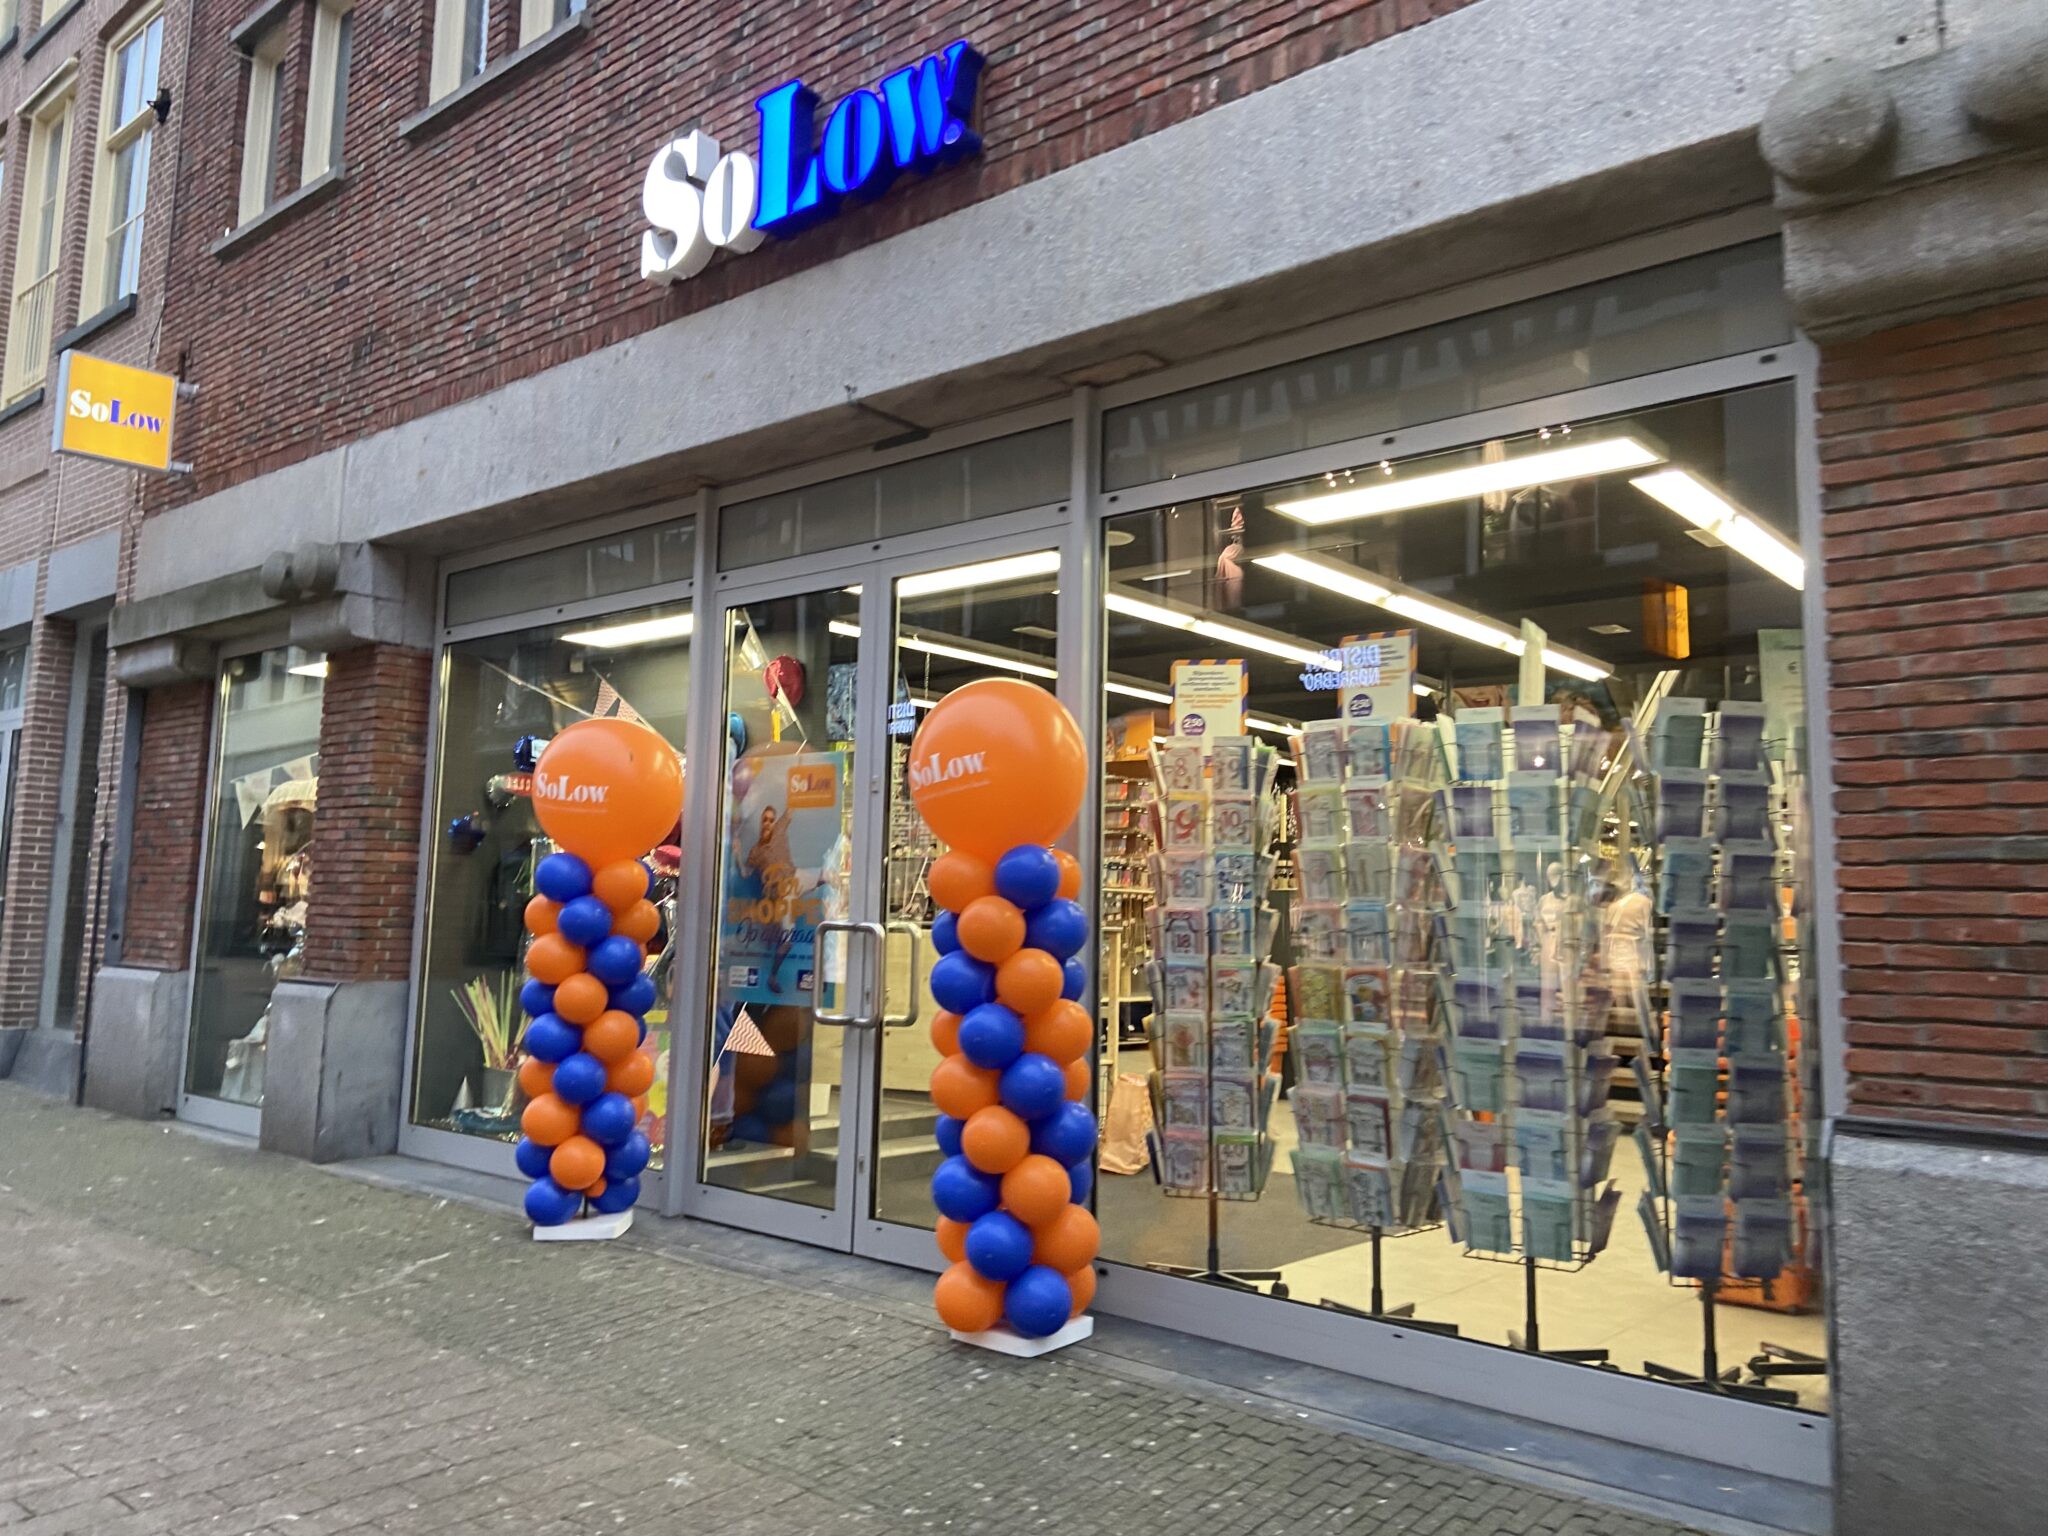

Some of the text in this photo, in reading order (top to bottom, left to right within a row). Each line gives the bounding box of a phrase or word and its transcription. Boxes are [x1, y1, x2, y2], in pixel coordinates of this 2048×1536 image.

[70, 388, 165, 433] SoLow
[535, 771, 610, 804] SoLow
[911, 750, 988, 792] SoLow
